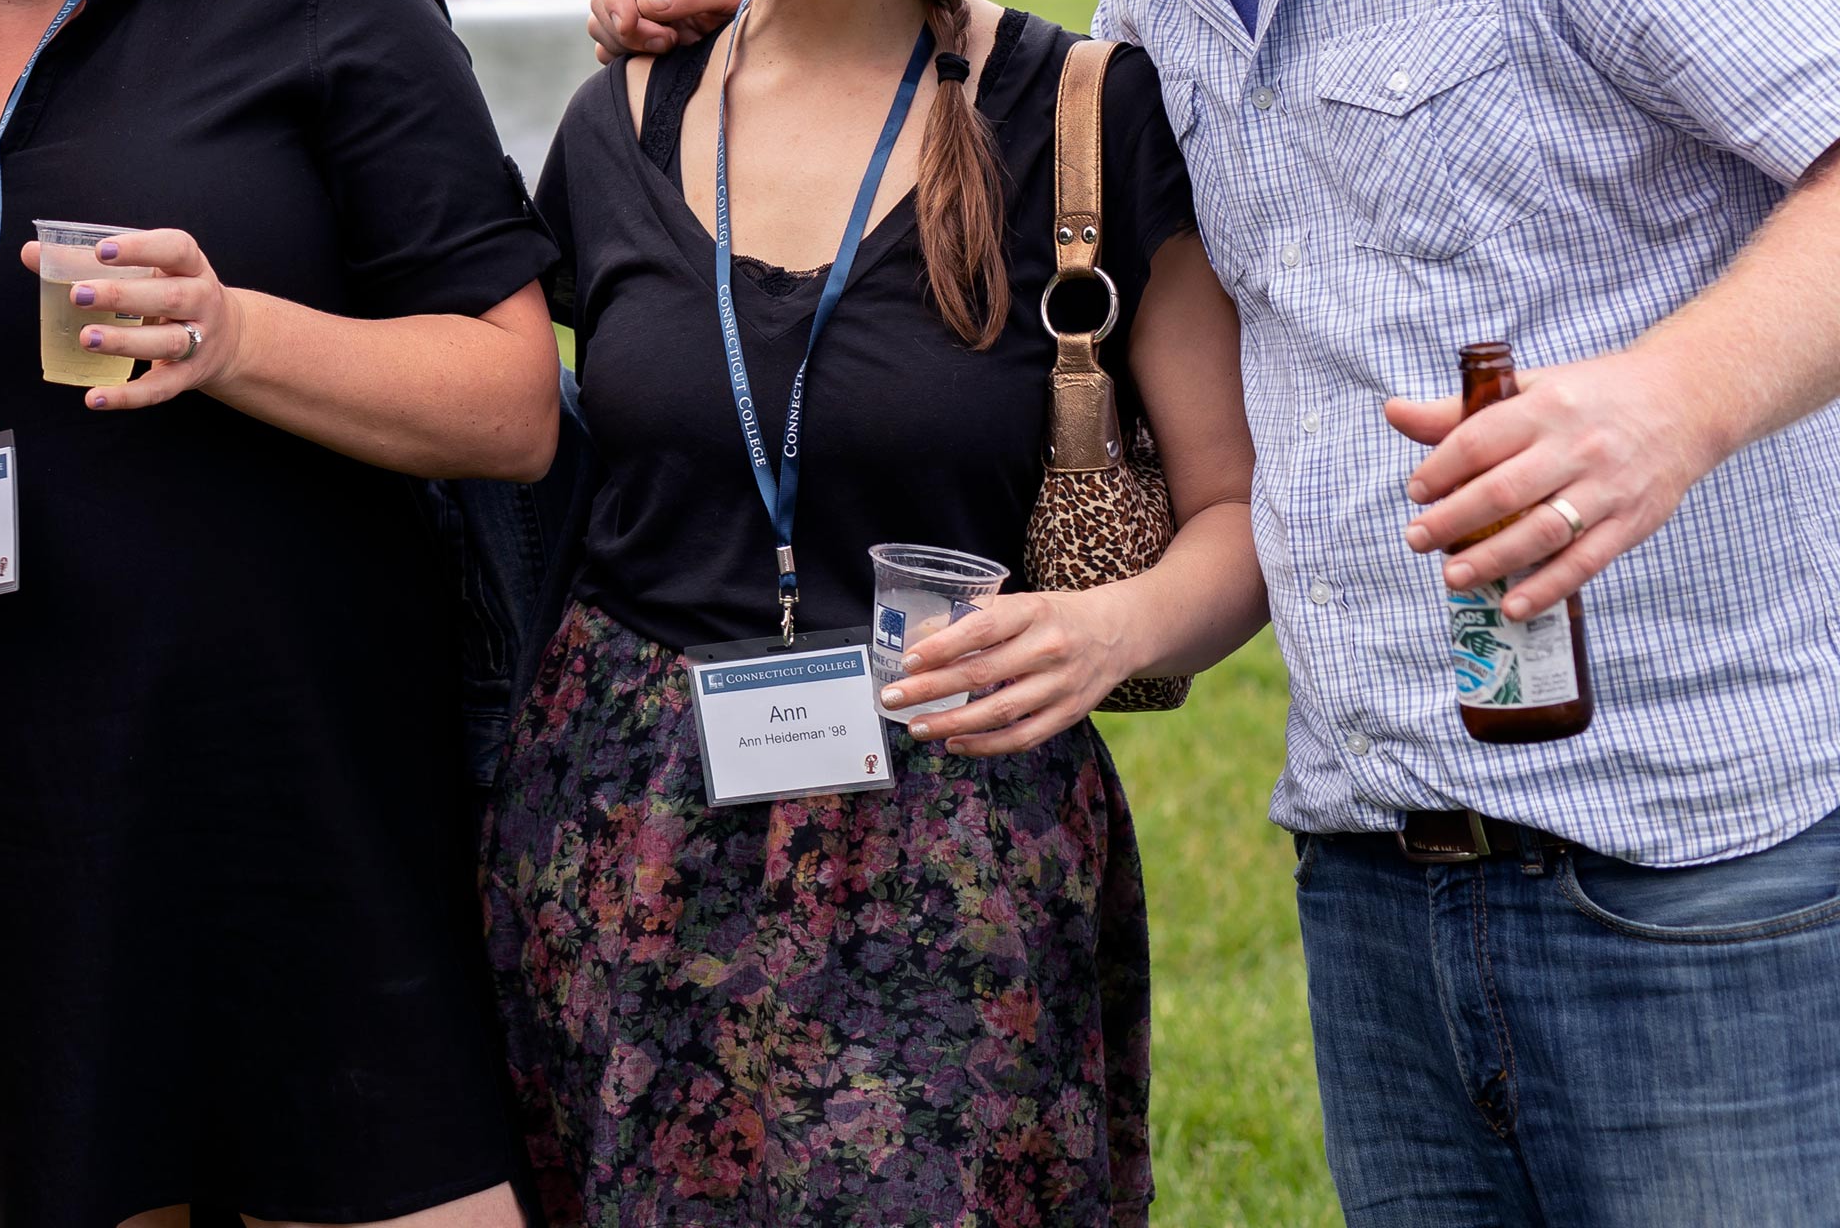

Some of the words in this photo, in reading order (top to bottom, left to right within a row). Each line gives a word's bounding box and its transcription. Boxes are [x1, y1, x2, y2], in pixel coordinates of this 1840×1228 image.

[717, 184, 728, 249] COLLEGE
[719, 284, 747, 392] CONNECTICUT
[738, 396, 767, 468] COLLEGE
[726, 666, 804, 684] CONNECTICUT
[807, 660, 857, 674] COLLEGE
[770, 705, 807, 723] Ann
[738, 737, 762, 748] Ann
[765, 727, 826, 744] Heideman
[828, 725, 847, 737] '98
